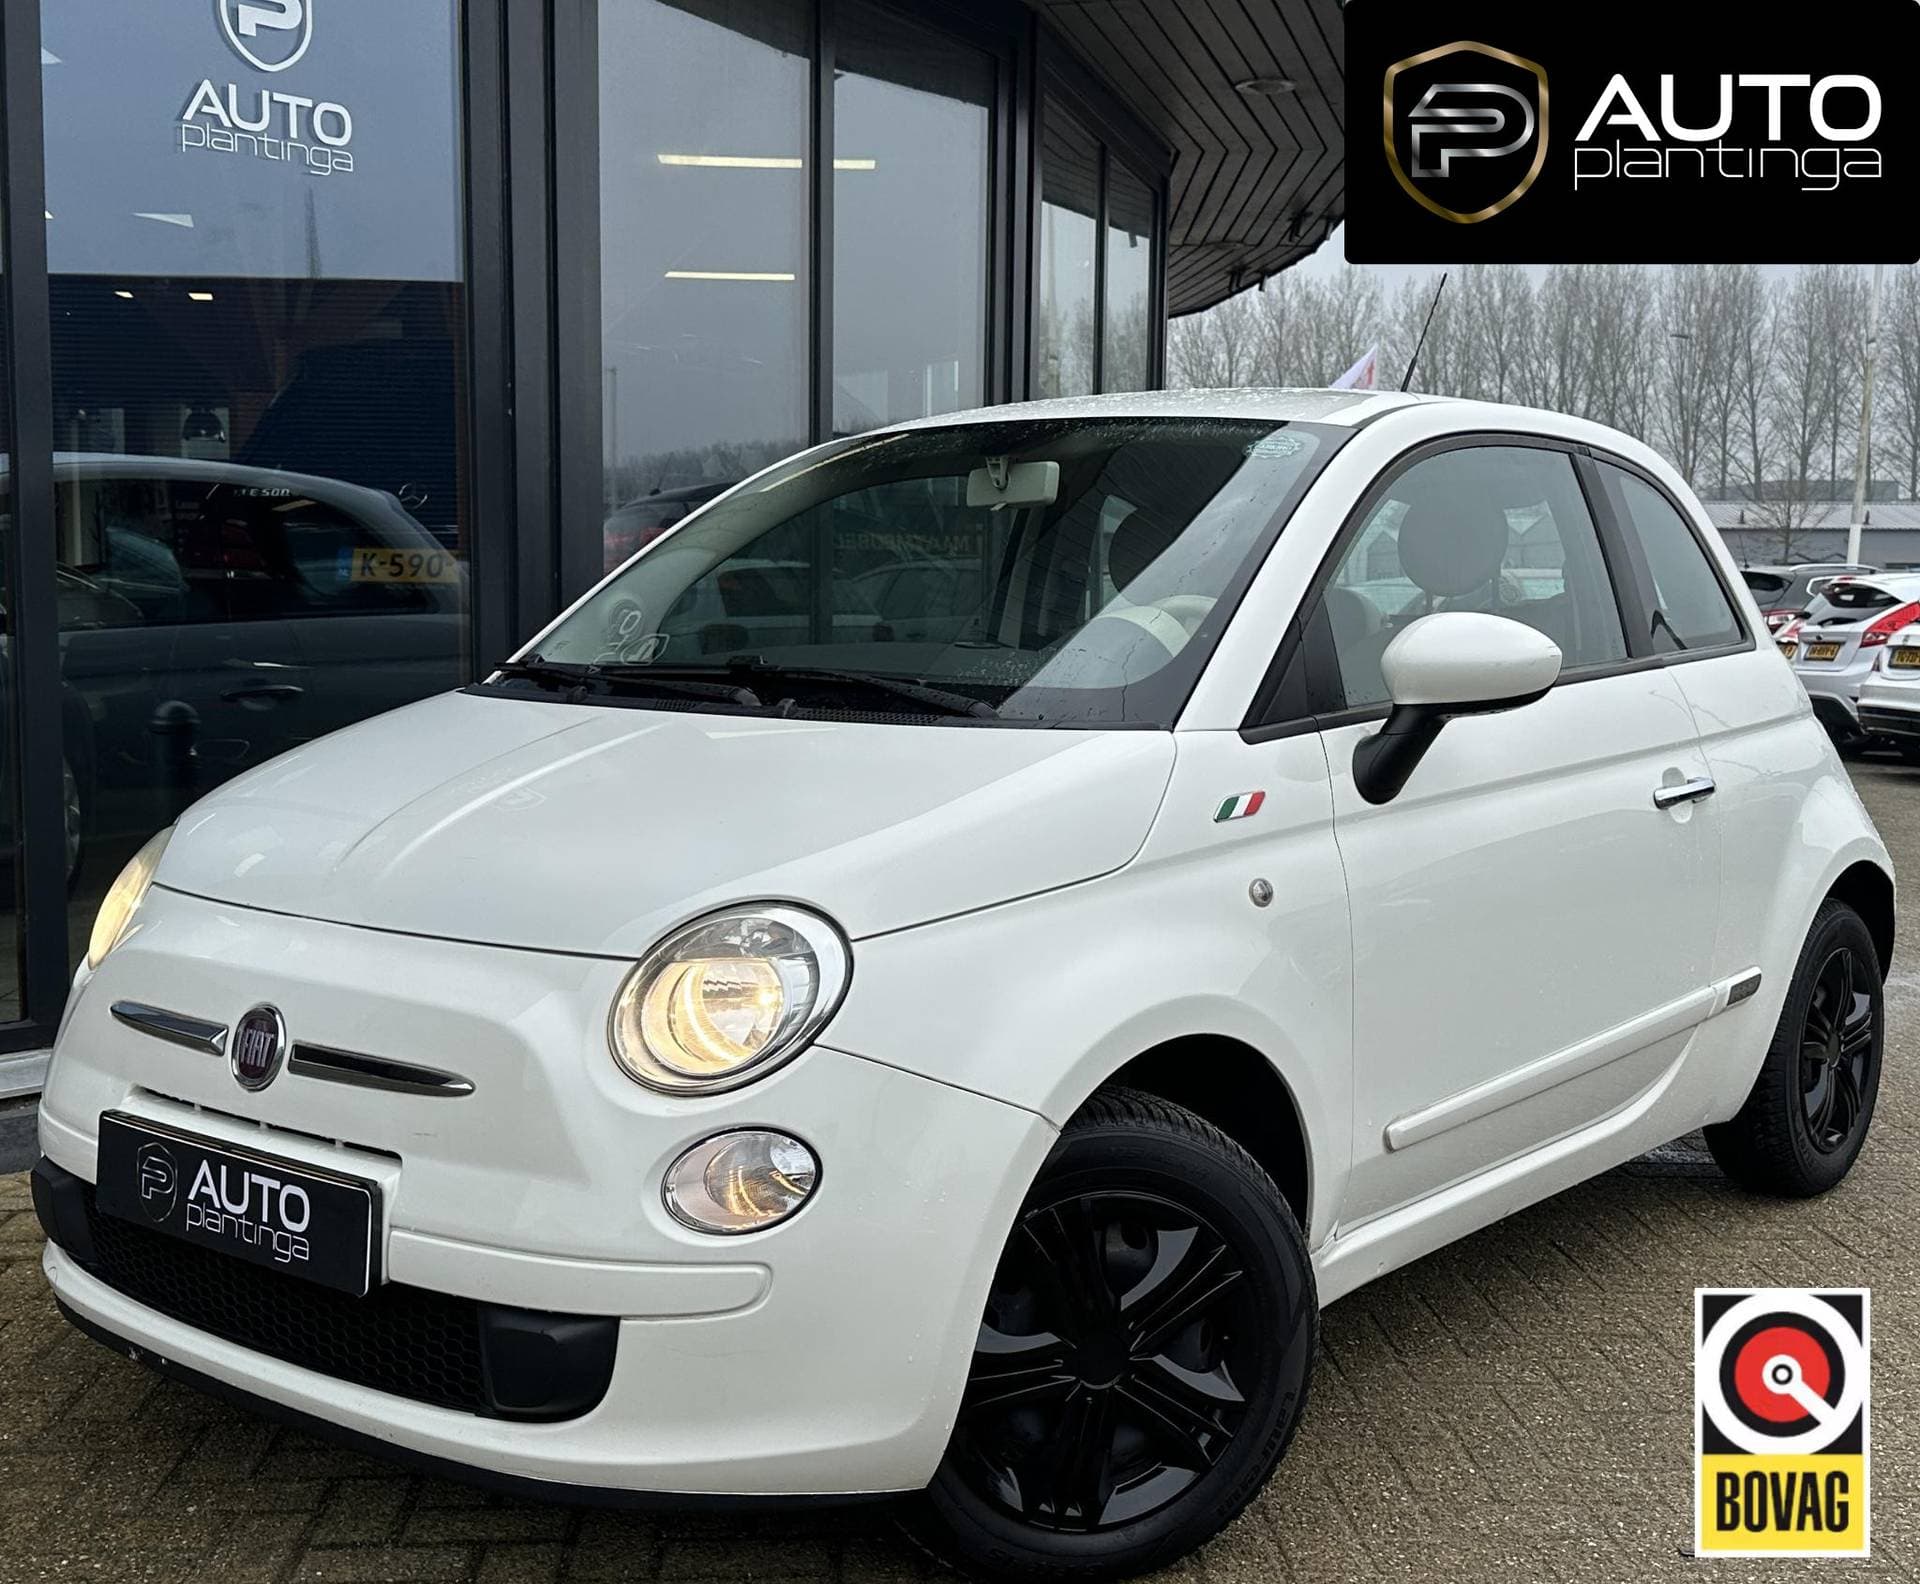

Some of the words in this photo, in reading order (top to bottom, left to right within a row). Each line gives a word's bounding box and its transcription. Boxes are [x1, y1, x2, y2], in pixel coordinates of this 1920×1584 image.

[182, 79, 353, 147] AUTO
[182, 122, 354, 176] plantinga
[241, 1027, 275, 1068] FIAT
[187, 1159, 310, 1233] AUTO
[186, 1201, 310, 1263] plantinga
